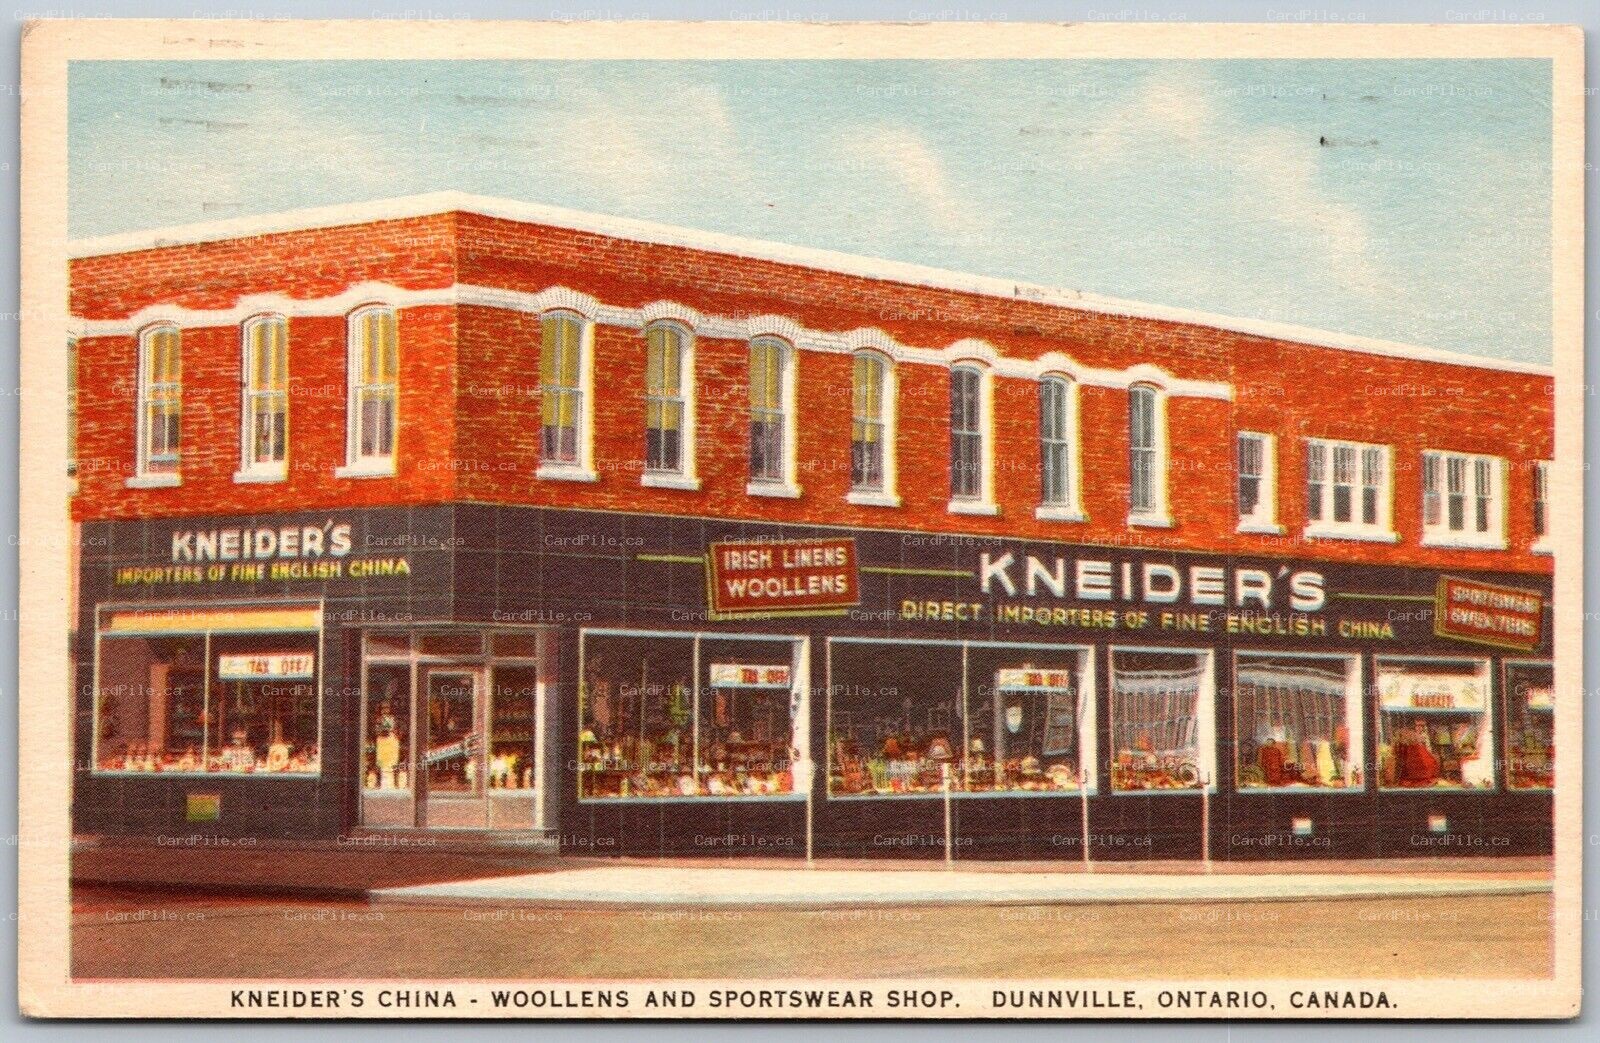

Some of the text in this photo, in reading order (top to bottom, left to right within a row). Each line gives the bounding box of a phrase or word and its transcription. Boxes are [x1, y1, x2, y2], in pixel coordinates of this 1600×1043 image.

[171, 519, 353, 560] KNEIDER'S
[117, 556, 411, 585] IMPORTERS OF FINE ENGLISH CHINA
[724, 546, 847, 570] IRISH LINENS
[726, 574, 848, 598] WOOLLENS
[980, 552, 1327, 612] KNEIDER'S
[902, 601, 982, 621] DIRECT
[998, 605, 1116, 629] IMPORTERS
[1125, 611, 1147, 629] OF
[1161, 612, 1210, 632] FINE
[1226, 615, 1326, 636] ENGLISH
[1338, 619, 1394, 639] CHINA
[231, 989, 364, 1008] KNEIDER'S
[378, 990, 457, 1008] CHINA
[491, 990, 629, 1008] WOOLLENS
[645, 990, 696, 1008] AND
[709, 990, 873, 1008] SPORTSWEAR
[887, 990, 960, 1008] SHOP.
[992, 990, 1143, 1010] DUNNVILLE,
[1158, 990, 1275, 1010] ONTARIO,
[1290, 991, 1398, 1009] CANADA.
